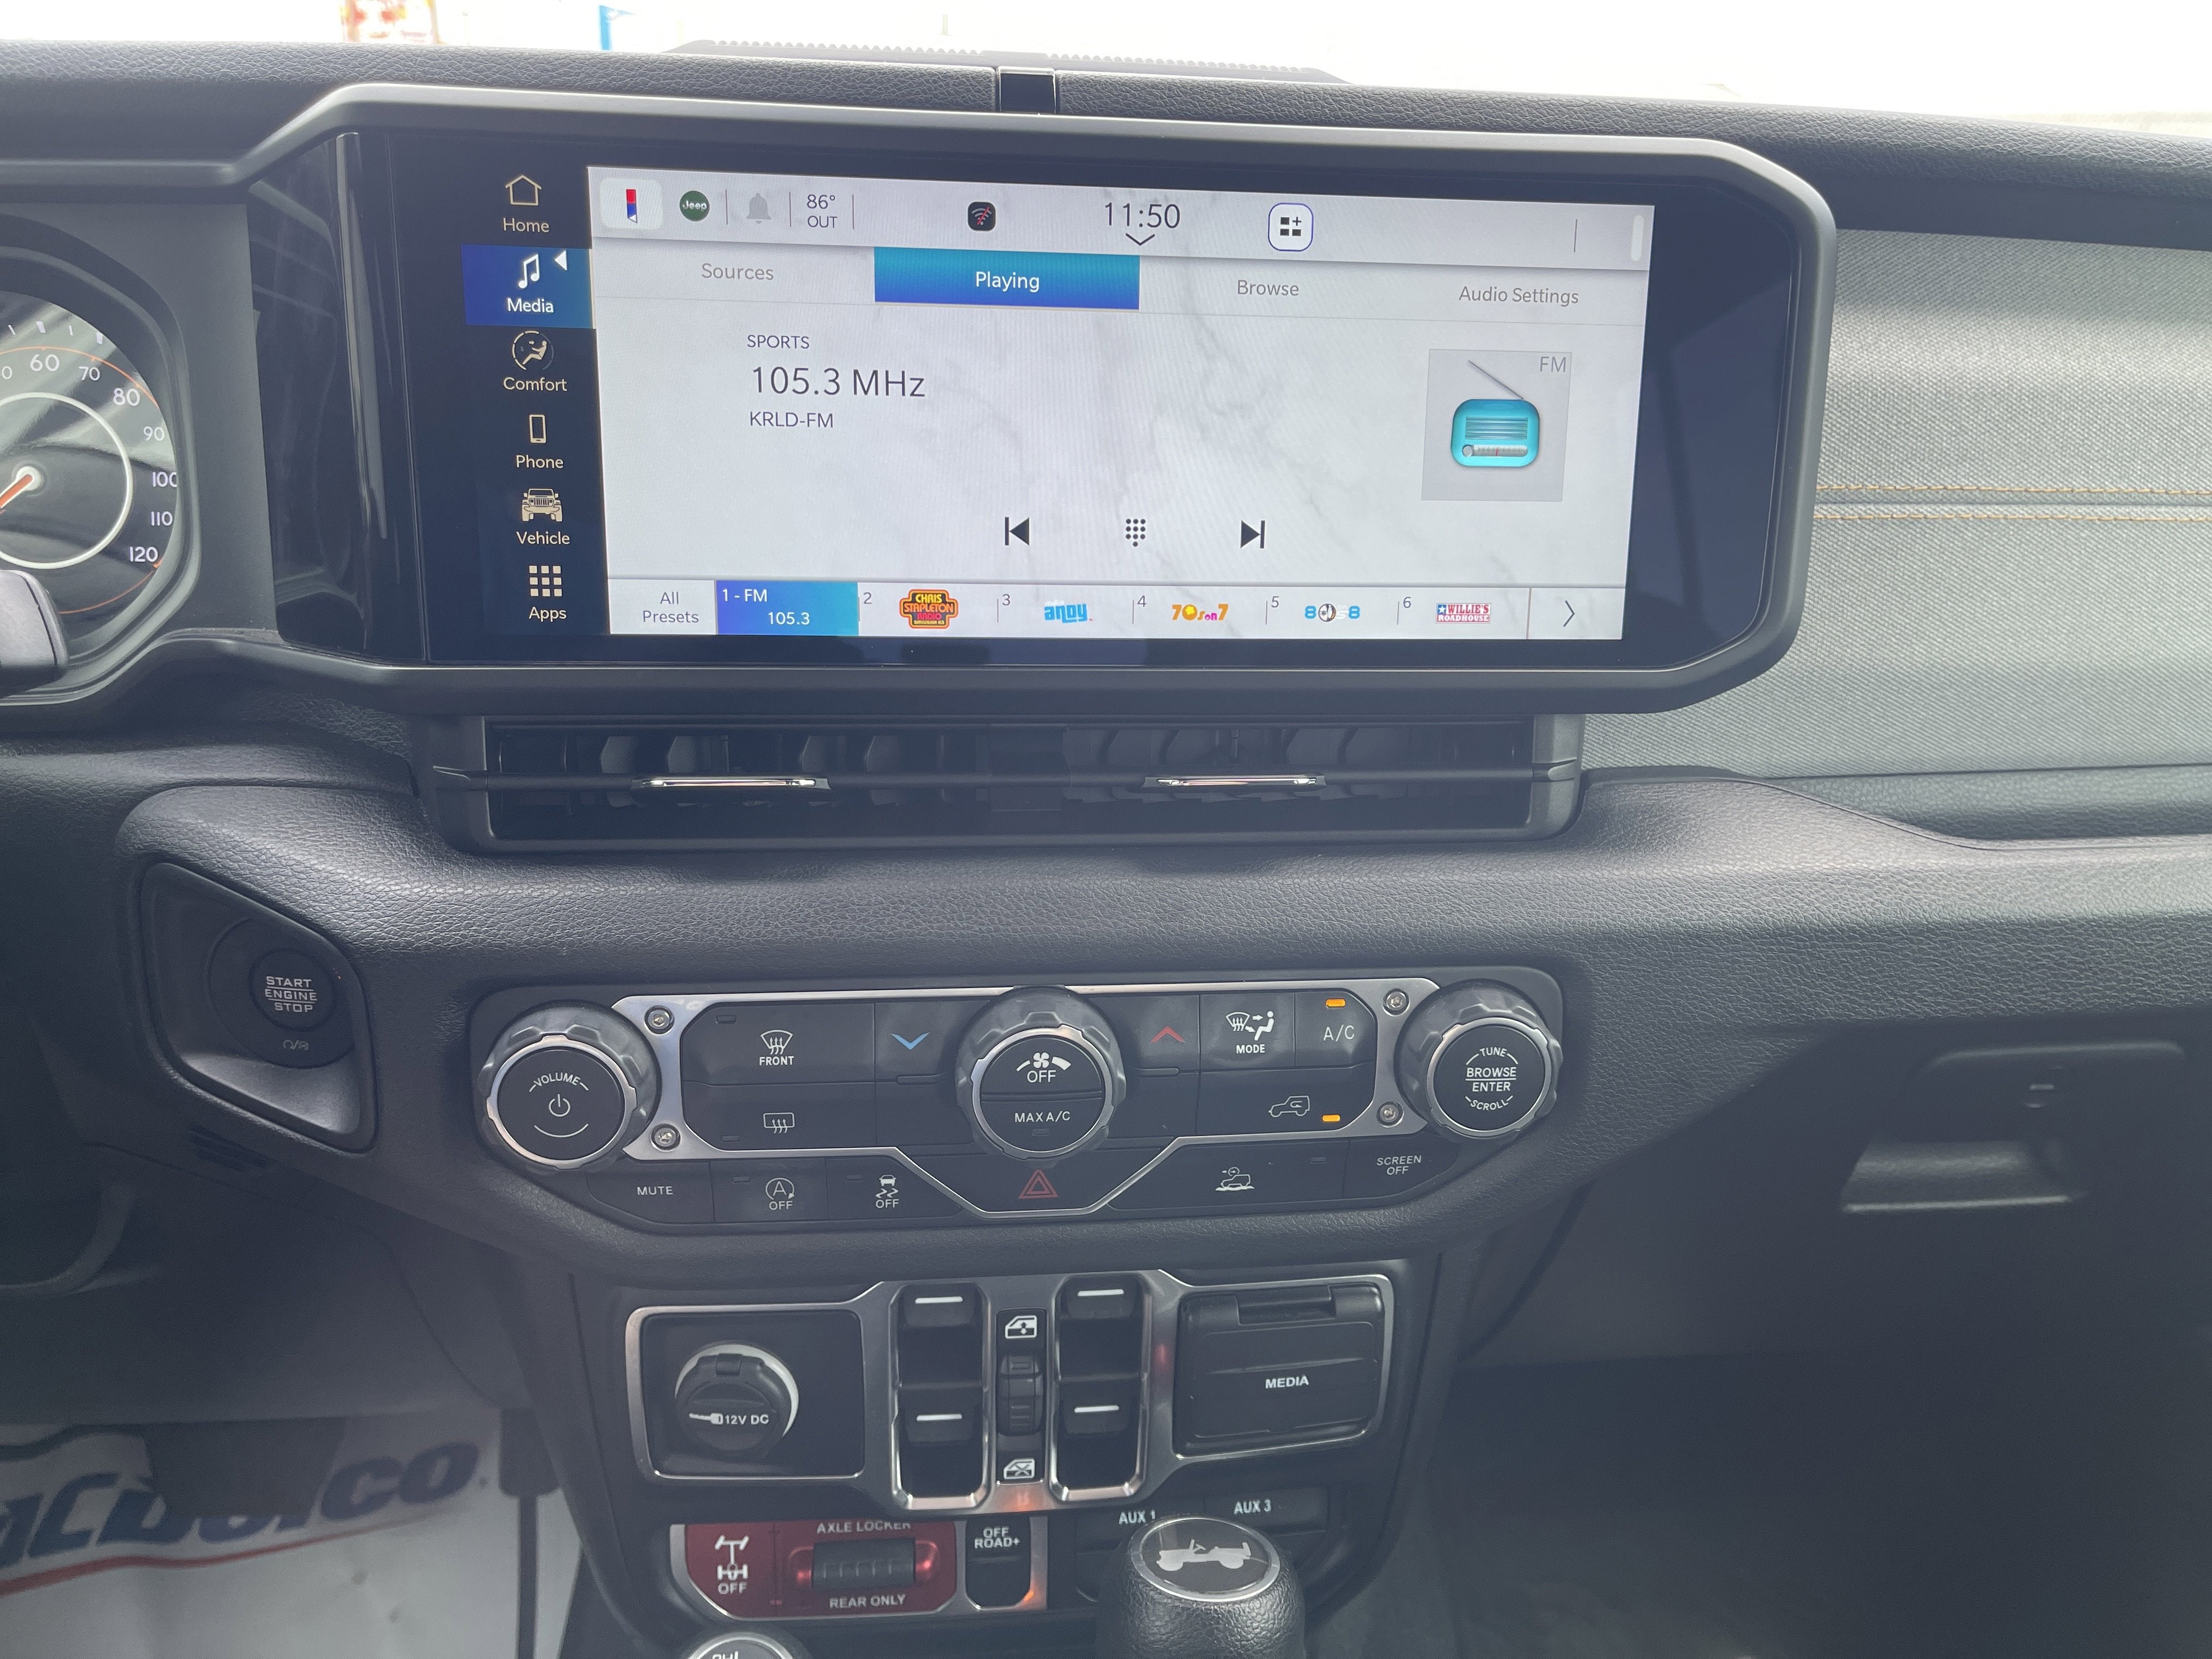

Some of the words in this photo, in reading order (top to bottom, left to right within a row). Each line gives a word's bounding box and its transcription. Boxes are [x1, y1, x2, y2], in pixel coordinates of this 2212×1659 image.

[682, 200, 708, 212] Jeep
[806, 194, 836, 210] 86°
[1105, 202, 1180, 229] 11:50
[503, 217, 549, 233] Home
[807, 215, 838, 228] OUT
[701, 263, 774, 280] Sources
[976, 270, 1040, 293] Playing
[1237, 279, 1299, 296] Browse
[1458, 286, 1508, 302] Audio
[1512, 287, 1579, 307] Settings
[507, 297, 554, 313] Media
[747, 334, 810, 349] SPORTS
[30, 354, 60, 372] 60
[1539, 356, 1566, 373] FM
[78, 366, 101, 381] 70
[503, 377, 567, 391] Comfort
[753, 366, 840, 396] 105.3
[853, 369, 925, 397] MHz
[112, 387, 141, 407] 80
[750, 411, 833, 428] KRLD-FM
[143, 427, 165, 442] 90
[516, 454, 563, 469] Phone
[152, 471, 177, 488] 100
[151, 511, 173, 526] 110
[516, 531, 570, 545] Vehicle
[129, 546, 158, 562] 120
[659, 591, 679, 605] All
[723, 589, 728, 602] 1
[744, 589, 768, 602] FM
[863, 592, 872, 605] 2
[915, 594, 943, 603] CHRIS
[1002, 594, 1011, 606] 3
[1137, 595, 1147, 607] 4
[1271, 595, 1279, 608] 5
[1403, 596, 1412, 608] 6
[528, 606, 567, 623] Apps
[904, 603, 953, 613] STAPLETON
[1448, 605, 1489, 614] WILLIE'S
[642, 610, 699, 623] Presets
[768, 612, 810, 625] 105.3
[266, 975, 312, 988] START
[265, 989, 317, 1001] ENGINE
[274, 1002, 313, 1013] STOP
[1323, 1024, 1355, 1042] A/C
[1236, 1043, 1265, 1054] MODE
[1479, 1047, 1509, 1058] TUNE
[759, 1056, 794, 1066] FRONT
[1027, 1070, 1057, 1083] OFF
[1465, 1065, 1517, 1078] BROWSE
[534, 1072, 580, 1086] VOLUME
[1470, 1081, 1511, 1092] ENTER
[1468, 1098, 1509, 1111] SCROLL
[1014, 1112, 1043, 1122] MAX
[1046, 1110, 1070, 1122] A/C
[1376, 1155, 1422, 1166] SCREEN
[1386, 1165, 1409, 1176] OFF
[637, 1186, 673, 1195] MUTE
[769, 1200, 793, 1210] OFF
[876, 1197, 899, 1209] OFF
[1265, 1375, 1309, 1389] MEDIA
[724, 1413, 747, 1425] 12V
[751, 1414, 769, 1425] DC
[1234, 1501, 1261, 1515] AUX
[1263, 1499, 1271, 1512] 3
[1119, 1511, 1146, 1525] AUX
[1149, 1509, 1156, 1520] 1
[816, 1522, 854, 1535] AXLE
[982, 1527, 1011, 1537] OFF
[974, 1536, 1020, 1549] ROAD+
[718, 1582, 746, 1595] OFF
[830, 1596, 867, 1609] REAR
[870, 1594, 906, 1606] ONLY
